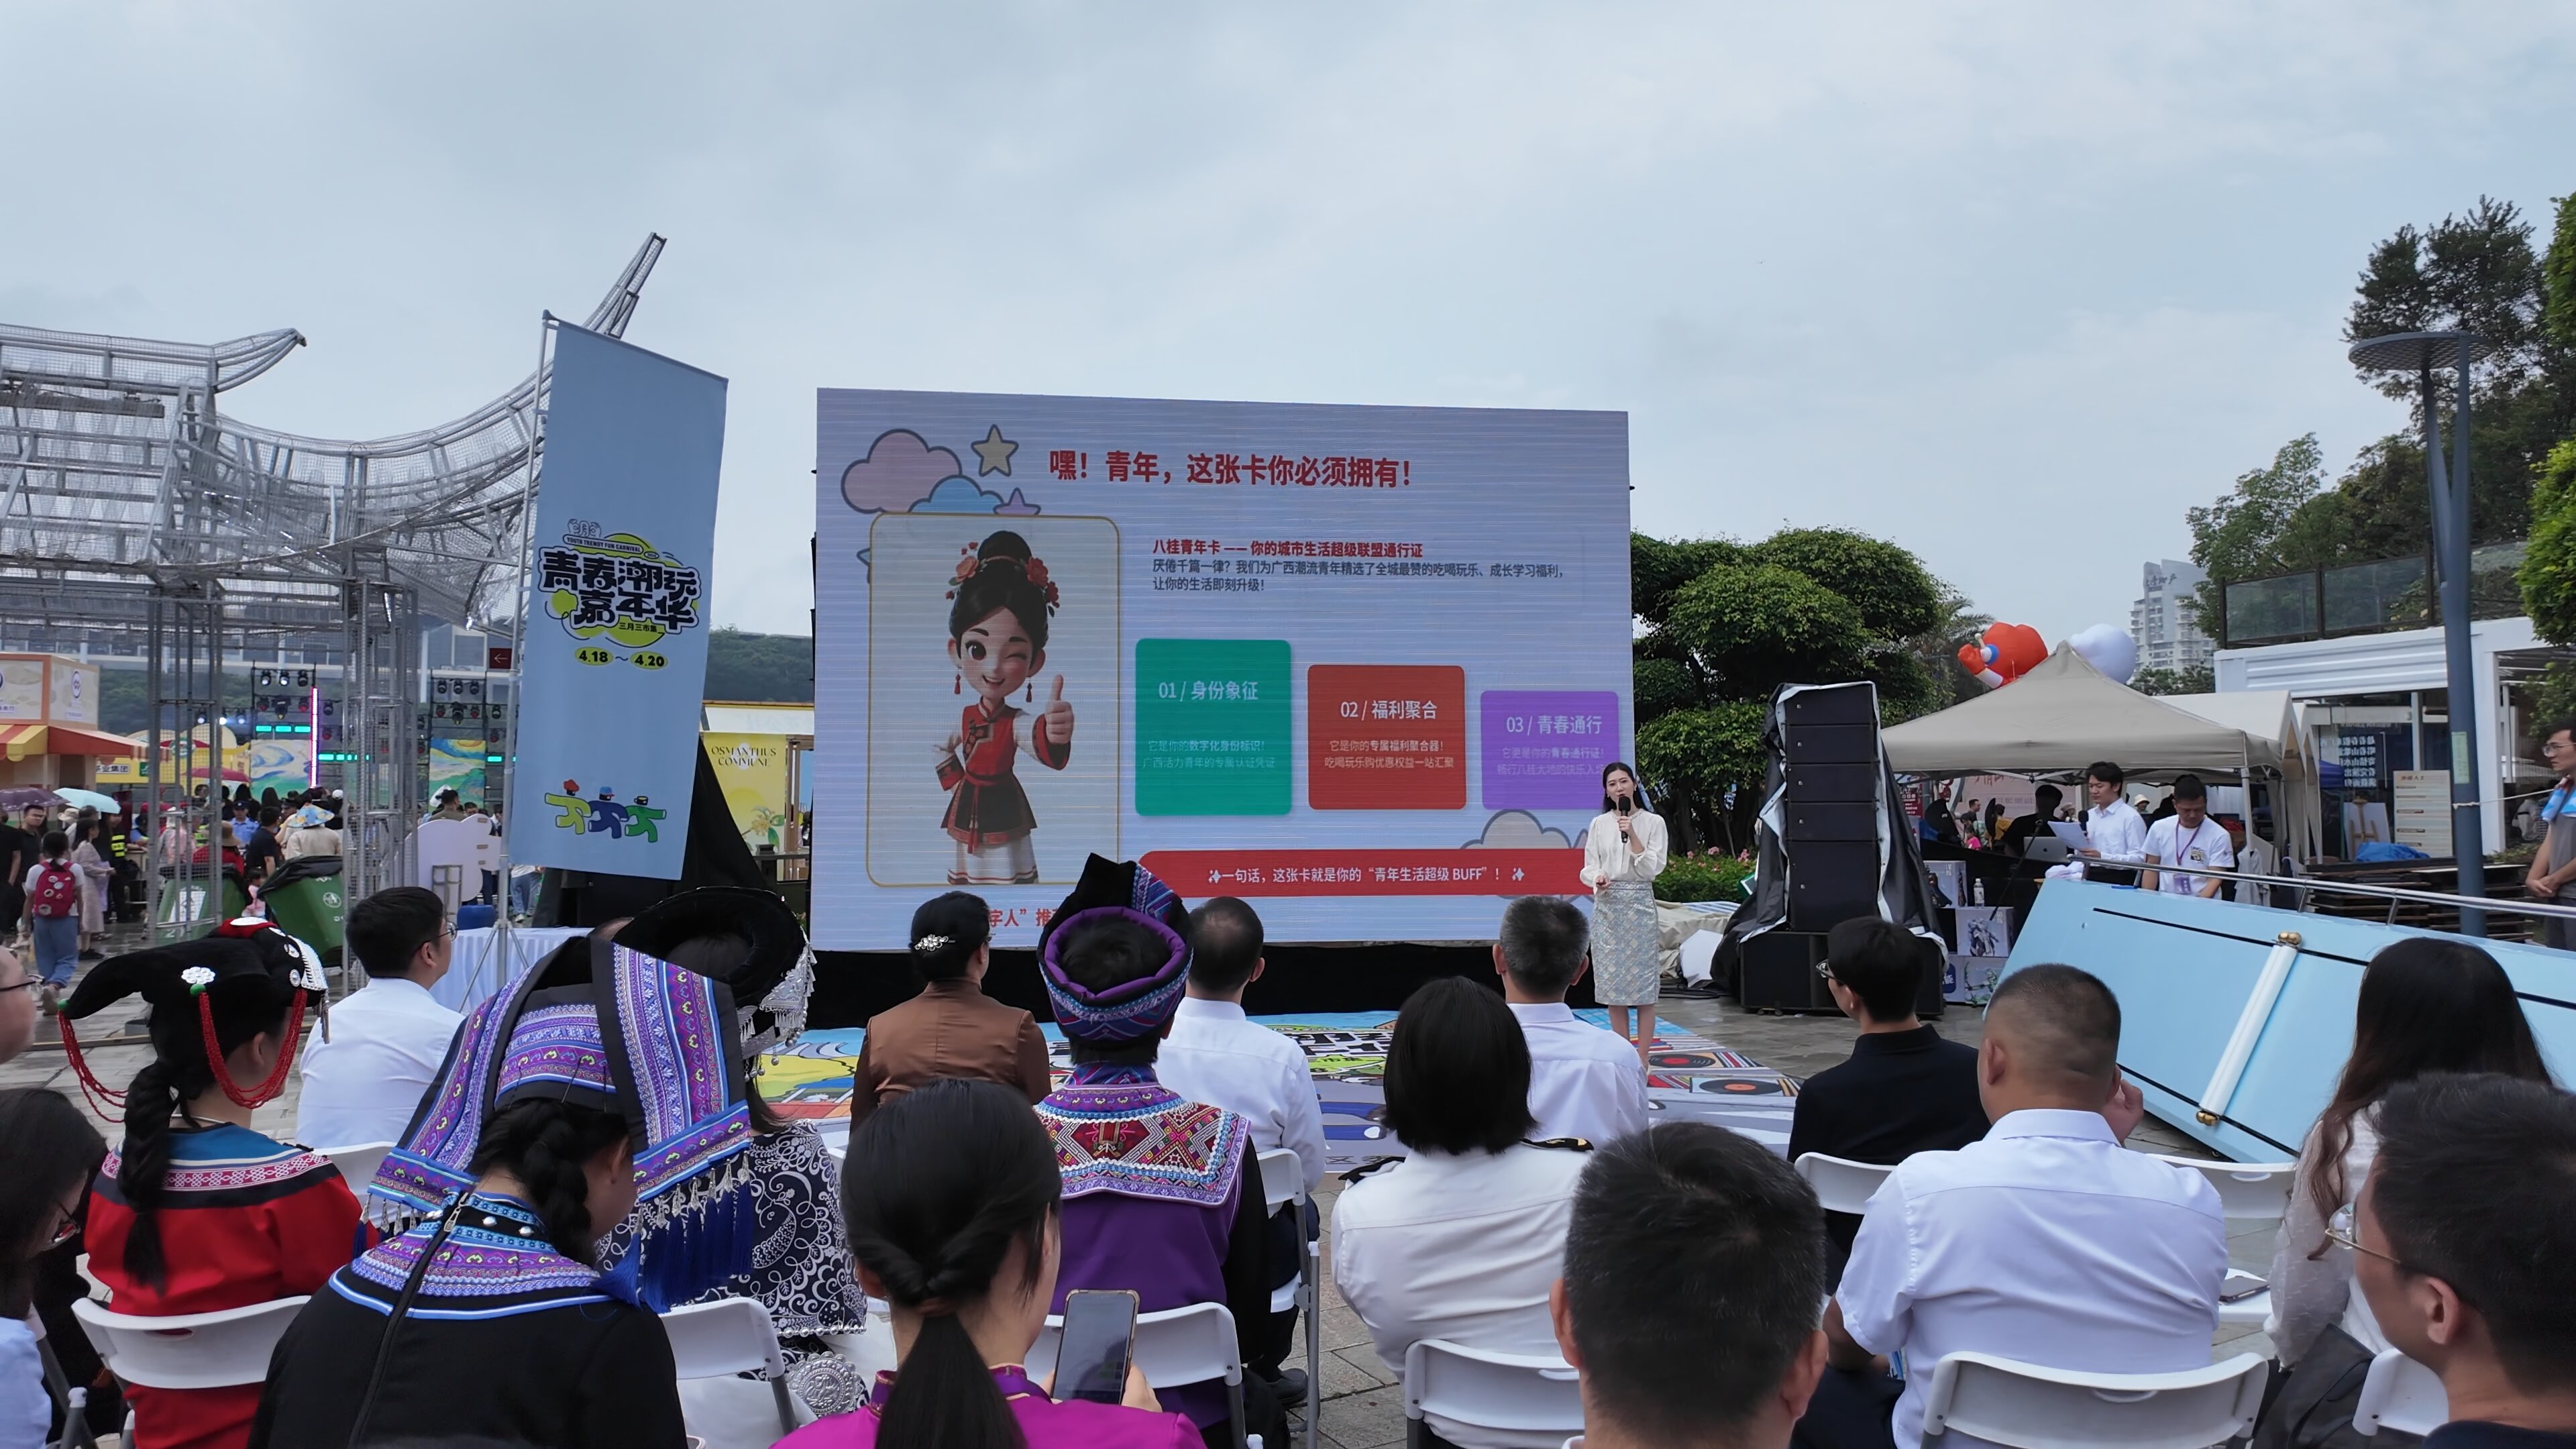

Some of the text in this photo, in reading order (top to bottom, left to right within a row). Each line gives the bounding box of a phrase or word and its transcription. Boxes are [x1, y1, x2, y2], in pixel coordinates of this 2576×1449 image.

[1049, 449, 1411, 488] 嘿！青年，这张卡你必须拥有！
[566, 536, 641, 553] YOUTH TRENDY FUN CARNIVAL
[1152, 539, 1220, 555] 八桂青年卡
[1250, 541, 1423, 558] 你的城市生活超级联盟通行证
[543, 550, 697, 601] 青春潮玩
[1153, 577, 1265, 592] 让你的生活即刻升级！
[574, 589, 694, 630] 嘉年华
[619, 622, 658, 633] 三月三市集
[579, 650, 608, 663] 4.18
[635, 655, 665, 667] 4.20
[1159, 682, 1177, 698] 01
[1191, 680, 1258, 700] 身份象征
[1340, 701, 1358, 718] 02
[1371, 700, 1438, 719] 福利聚合
[1506, 716, 1523, 733] 03
[1537, 715, 1602, 735] 青春通行
[712, 746, 776, 756] OSMANTHUS
[718, 757, 771, 767] COMMUNE
